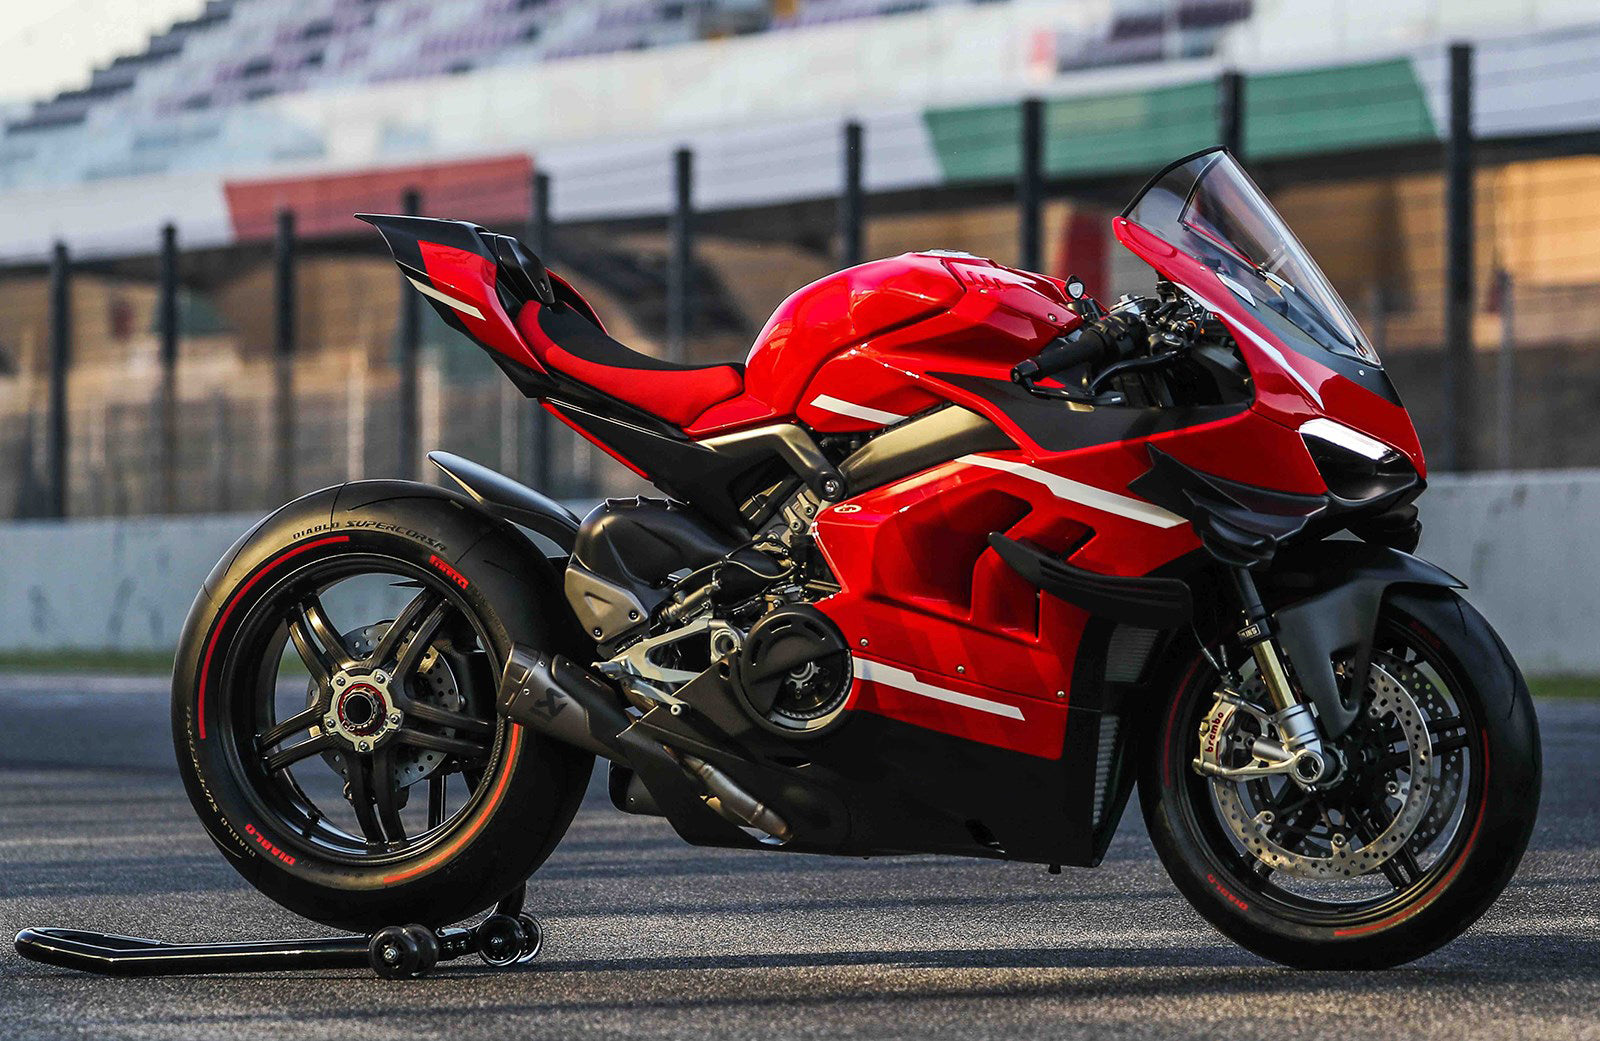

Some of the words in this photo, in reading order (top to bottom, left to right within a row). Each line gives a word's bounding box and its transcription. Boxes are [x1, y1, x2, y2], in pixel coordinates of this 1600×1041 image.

[292, 521, 340, 540] DIABLO
[345, 520, 448, 552] SUPERCORSA
[1204, 712, 1224, 753] brembo
[220, 817, 256, 858] DIABLO
[245, 823, 296, 866] DIABLO
